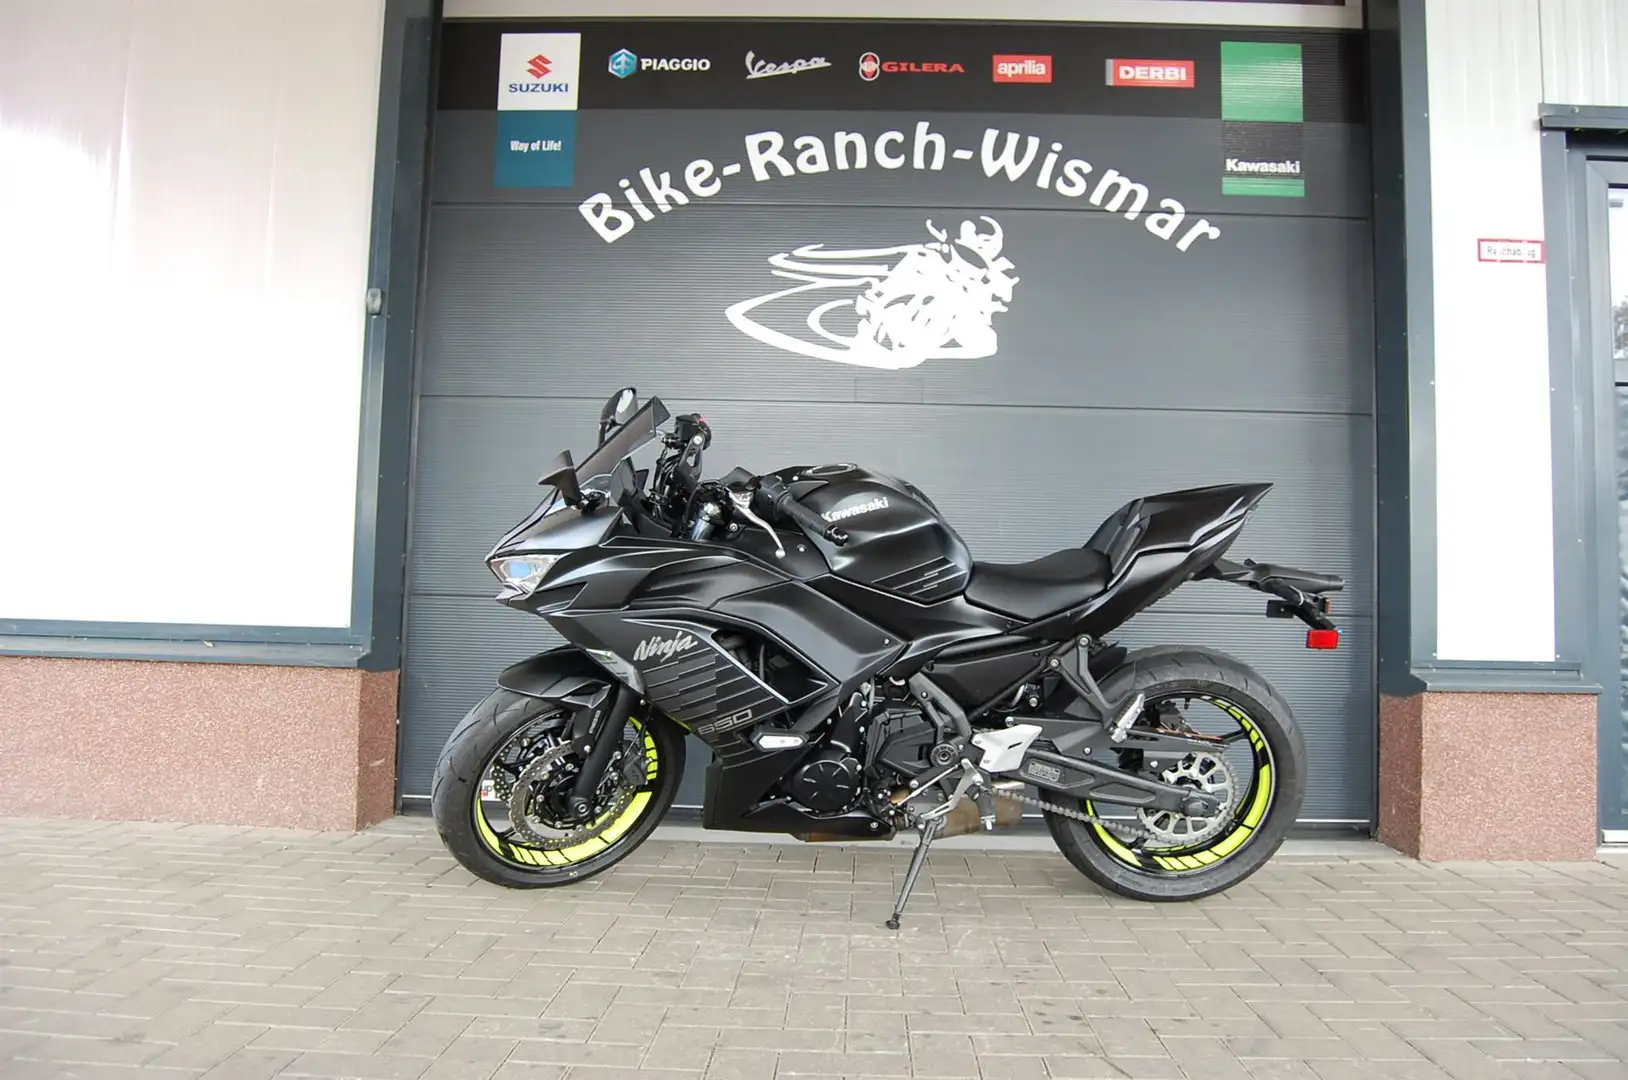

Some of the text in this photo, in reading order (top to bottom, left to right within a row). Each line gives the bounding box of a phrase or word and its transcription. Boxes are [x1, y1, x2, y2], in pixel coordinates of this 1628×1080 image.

[640, 58, 711, 71] PIAGGIO
[745, 50, 832, 79] Vespa
[881, 61, 965, 73] GILERA
[997, 59, 1046, 78] aprilia
[1119, 66, 1187, 81] DERBI
[508, 83, 569, 93] SUZUKI
[510, 140, 562, 153] Way of Life!
[1225, 158, 1300, 174] Kawasaki
[578, 121, 1221, 252] Bike-Ranch-Wismar
[821, 497, 889, 522] Kawasaki
[633, 631, 698, 662] Ninja
[697, 709, 753, 735] 650
